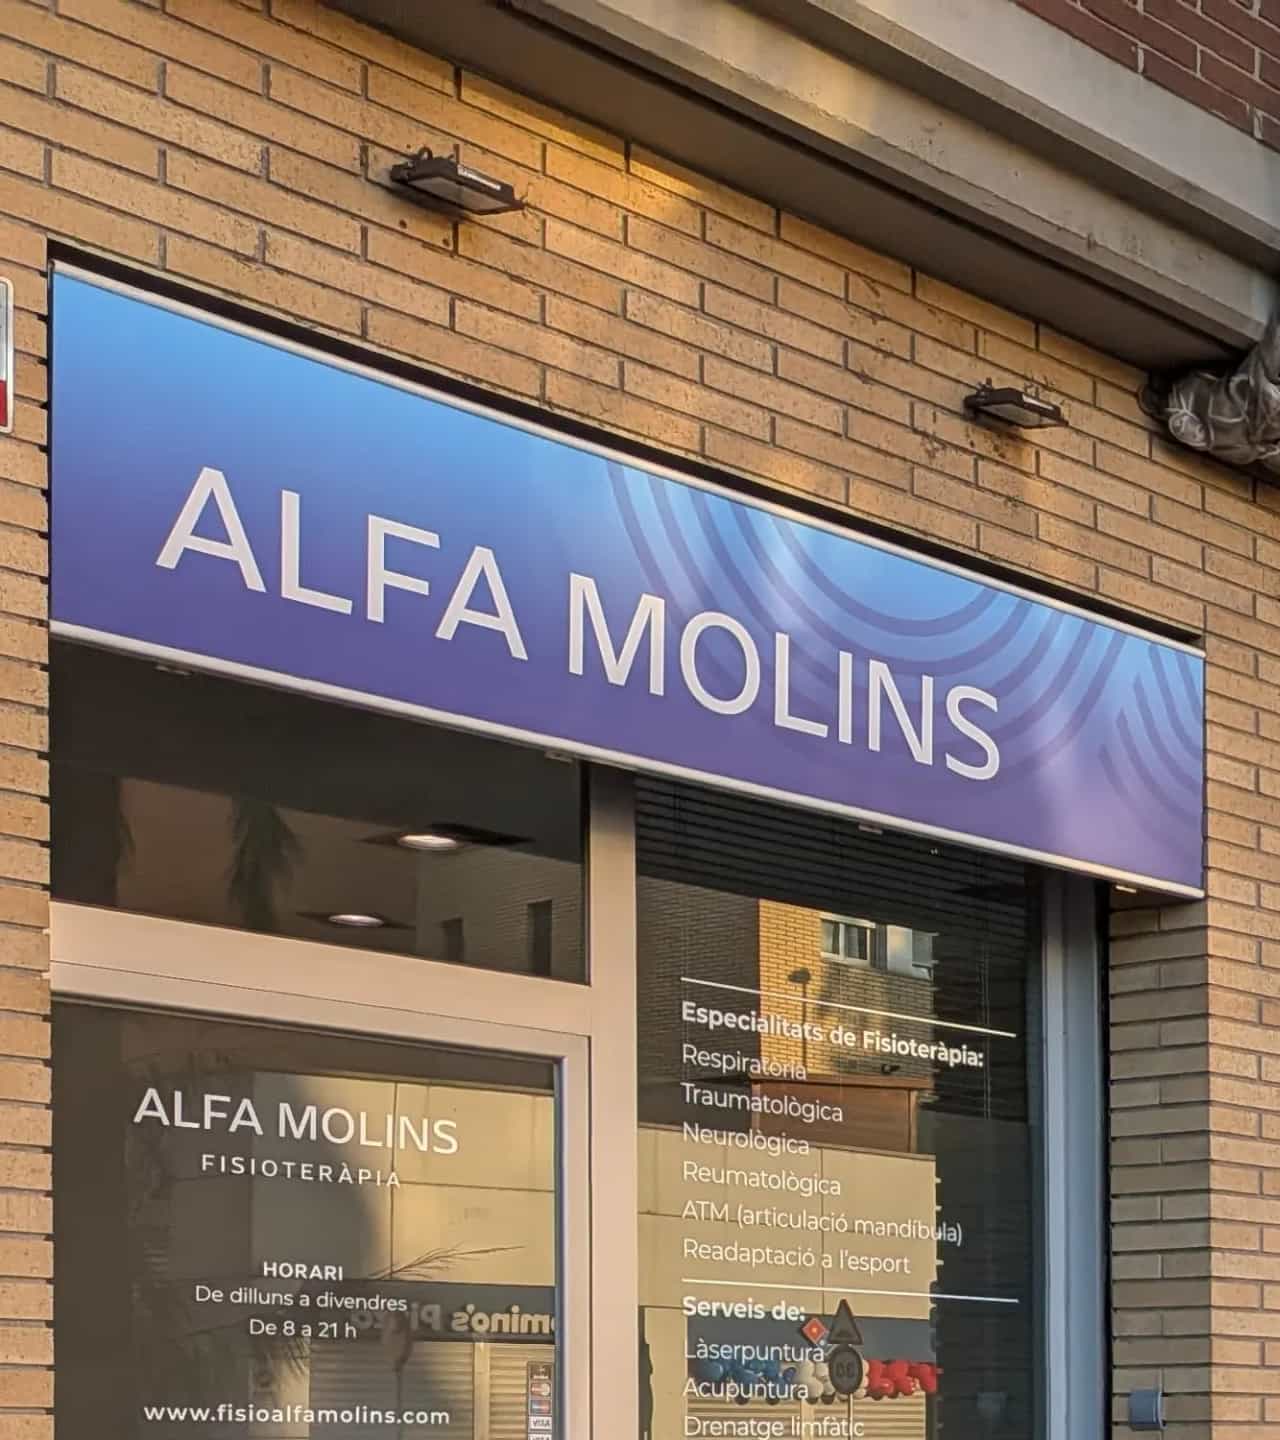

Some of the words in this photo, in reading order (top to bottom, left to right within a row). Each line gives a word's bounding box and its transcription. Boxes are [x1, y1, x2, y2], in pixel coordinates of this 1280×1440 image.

[155, 466, 529, 662] ALFA
[567, 572, 1001, 781] MOLINS
[681, 1001, 824, 1041] Especialitats
[830, 1023, 857, 1047] de
[863, 1029, 984, 1067] Fisioteràpia:
[682, 1044, 808, 1081] Respiratòria
[681, 1082, 844, 1123] Traumatològica
[133, 1087, 264, 1137] ALFA
[278, 1102, 458, 1155] MOLINS
[682, 1122, 809, 1156] Neurològica
[202, 1154, 401, 1188] FISIOTERÀPIA
[682, 1161, 841, 1197] Reumatològica
[682, 1201, 729, 1222] ATM
[737, 1203, 848, 1233] (articulació
[263, 1261, 344, 1282] HORARI
[683, 1239, 814, 1268] Readaptació
[822, 1252, 832, 1267] a
[839, 1247, 911, 1275] l'esport
[195, 1285, 224, 1303] De
[230, 1286, 294, 1307] dilluns
[299, 1294, 310, 1308] a
[316, 1291, 408, 1312] divendres
[682, 1297, 765, 1320] Serveis
[771, 1301, 806, 1321] de:
[249, 1319, 278, 1336] De
[283, 1320, 294, 1337] 8
[301, 1325, 312, 1339] a
[318, 1322, 339, 1339] 21
[345, 1323, 358, 1340] h
[682, 1376, 809, 1402] Acupuntura
[144, 1404, 450, 1426] www.fisioalfamolins.com
[684, 1415, 785, 1440] Drenatge
[791, 1415, 865, 1437] limfàtic
